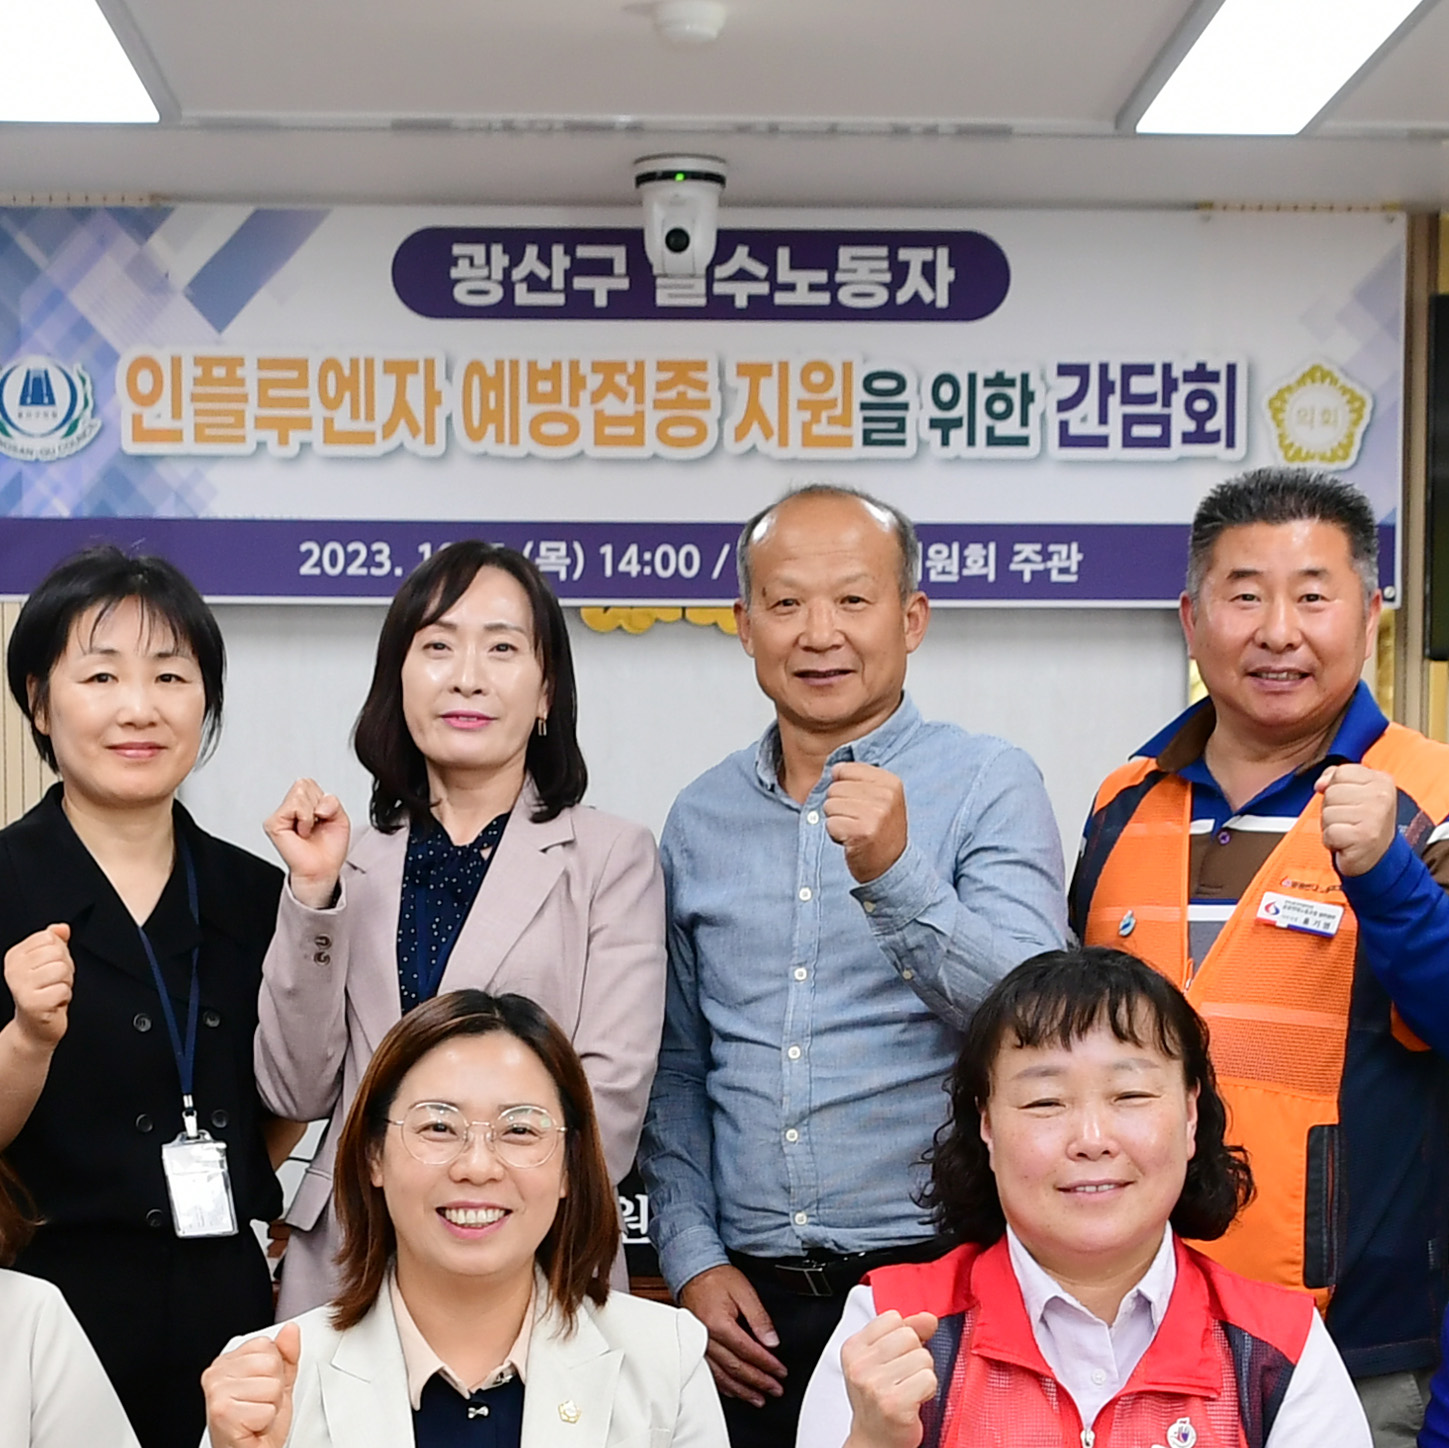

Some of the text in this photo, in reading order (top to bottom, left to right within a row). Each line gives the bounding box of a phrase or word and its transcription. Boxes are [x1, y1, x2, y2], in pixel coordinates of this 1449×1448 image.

[450, 241, 630, 307] 광산구
[126, 355, 1237, 450] 인플루엔자 예방접종 지원을 위한 간담회
[299, 541, 403, 577] 2023.
[600, 543, 701, 579] 14:00
[712, 543, 730, 580] /
[917, 541, 996, 583] 원회
[1009, 541, 1083, 583] 주관
